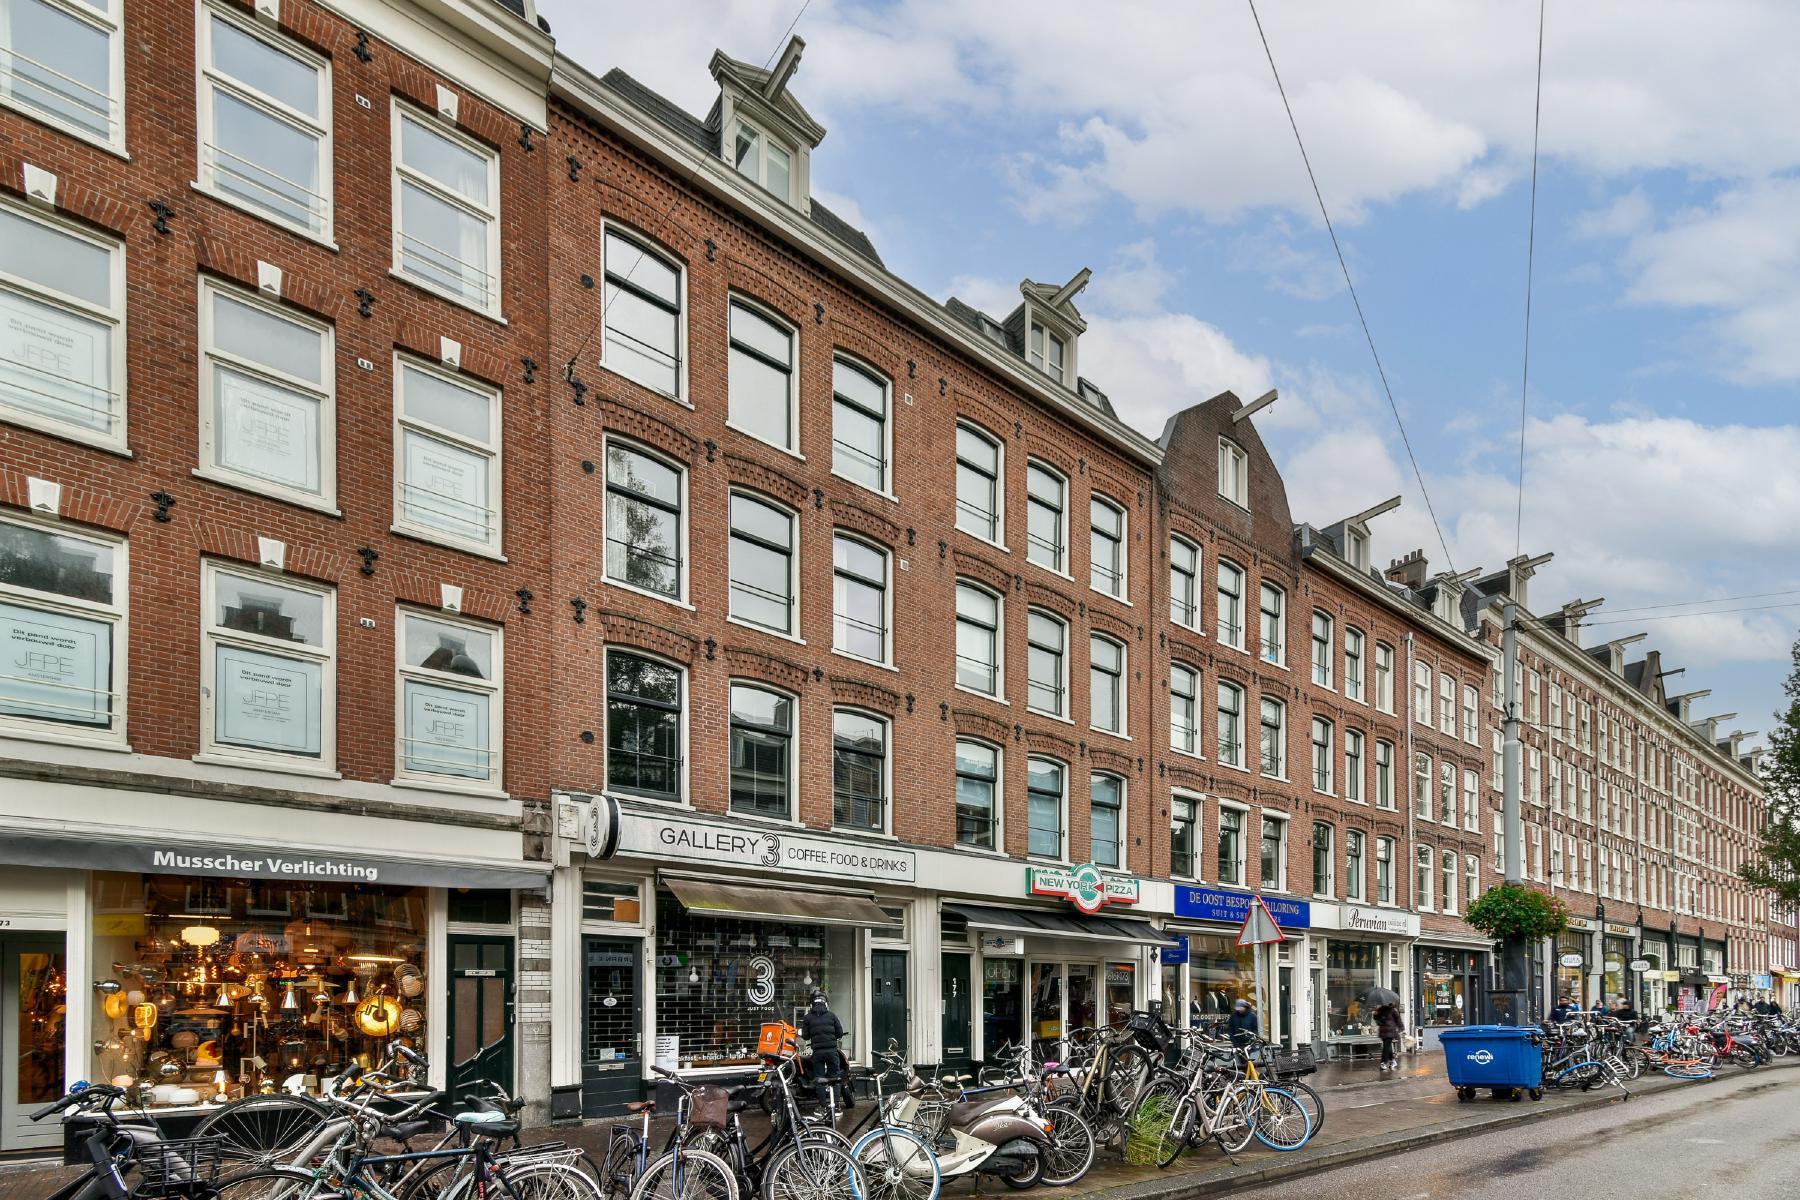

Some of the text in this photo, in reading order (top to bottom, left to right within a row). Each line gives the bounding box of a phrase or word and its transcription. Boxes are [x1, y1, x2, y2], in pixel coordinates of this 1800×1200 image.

[11, 635, 55, 647] verbouwd
[13, 628, 77, 645] Dit pand wordt
[14, 650, 75, 675] JFPE
[242, 689, 290, 709] JFPE
[425, 720, 464, 737] JFPE
[660, 827, 781, 868] GALLERY 3
[153, 850, 378, 881] Musscher Verlichting
[830, 852, 859, 867] FOOD
[860, 856, 868, 868] &
[869, 857, 907, 872] DRINKS
[1040, 877, 1133, 895] NEW YORK PIZZA
[1189, 891, 1201, 903] DE
[1202, 893, 1225, 906] OOST
[1211, 909, 1227, 918] SUIT
[1349, 907, 1387, 931] Peruvian
[747, 956, 775, 1005] 3
[987, 967, 1015, 979] OPEN
[702, 1053, 724, 1061] brunch
[729, 1052, 746, 1060] lunch
[1467, 1052, 1493, 1060] renewi
